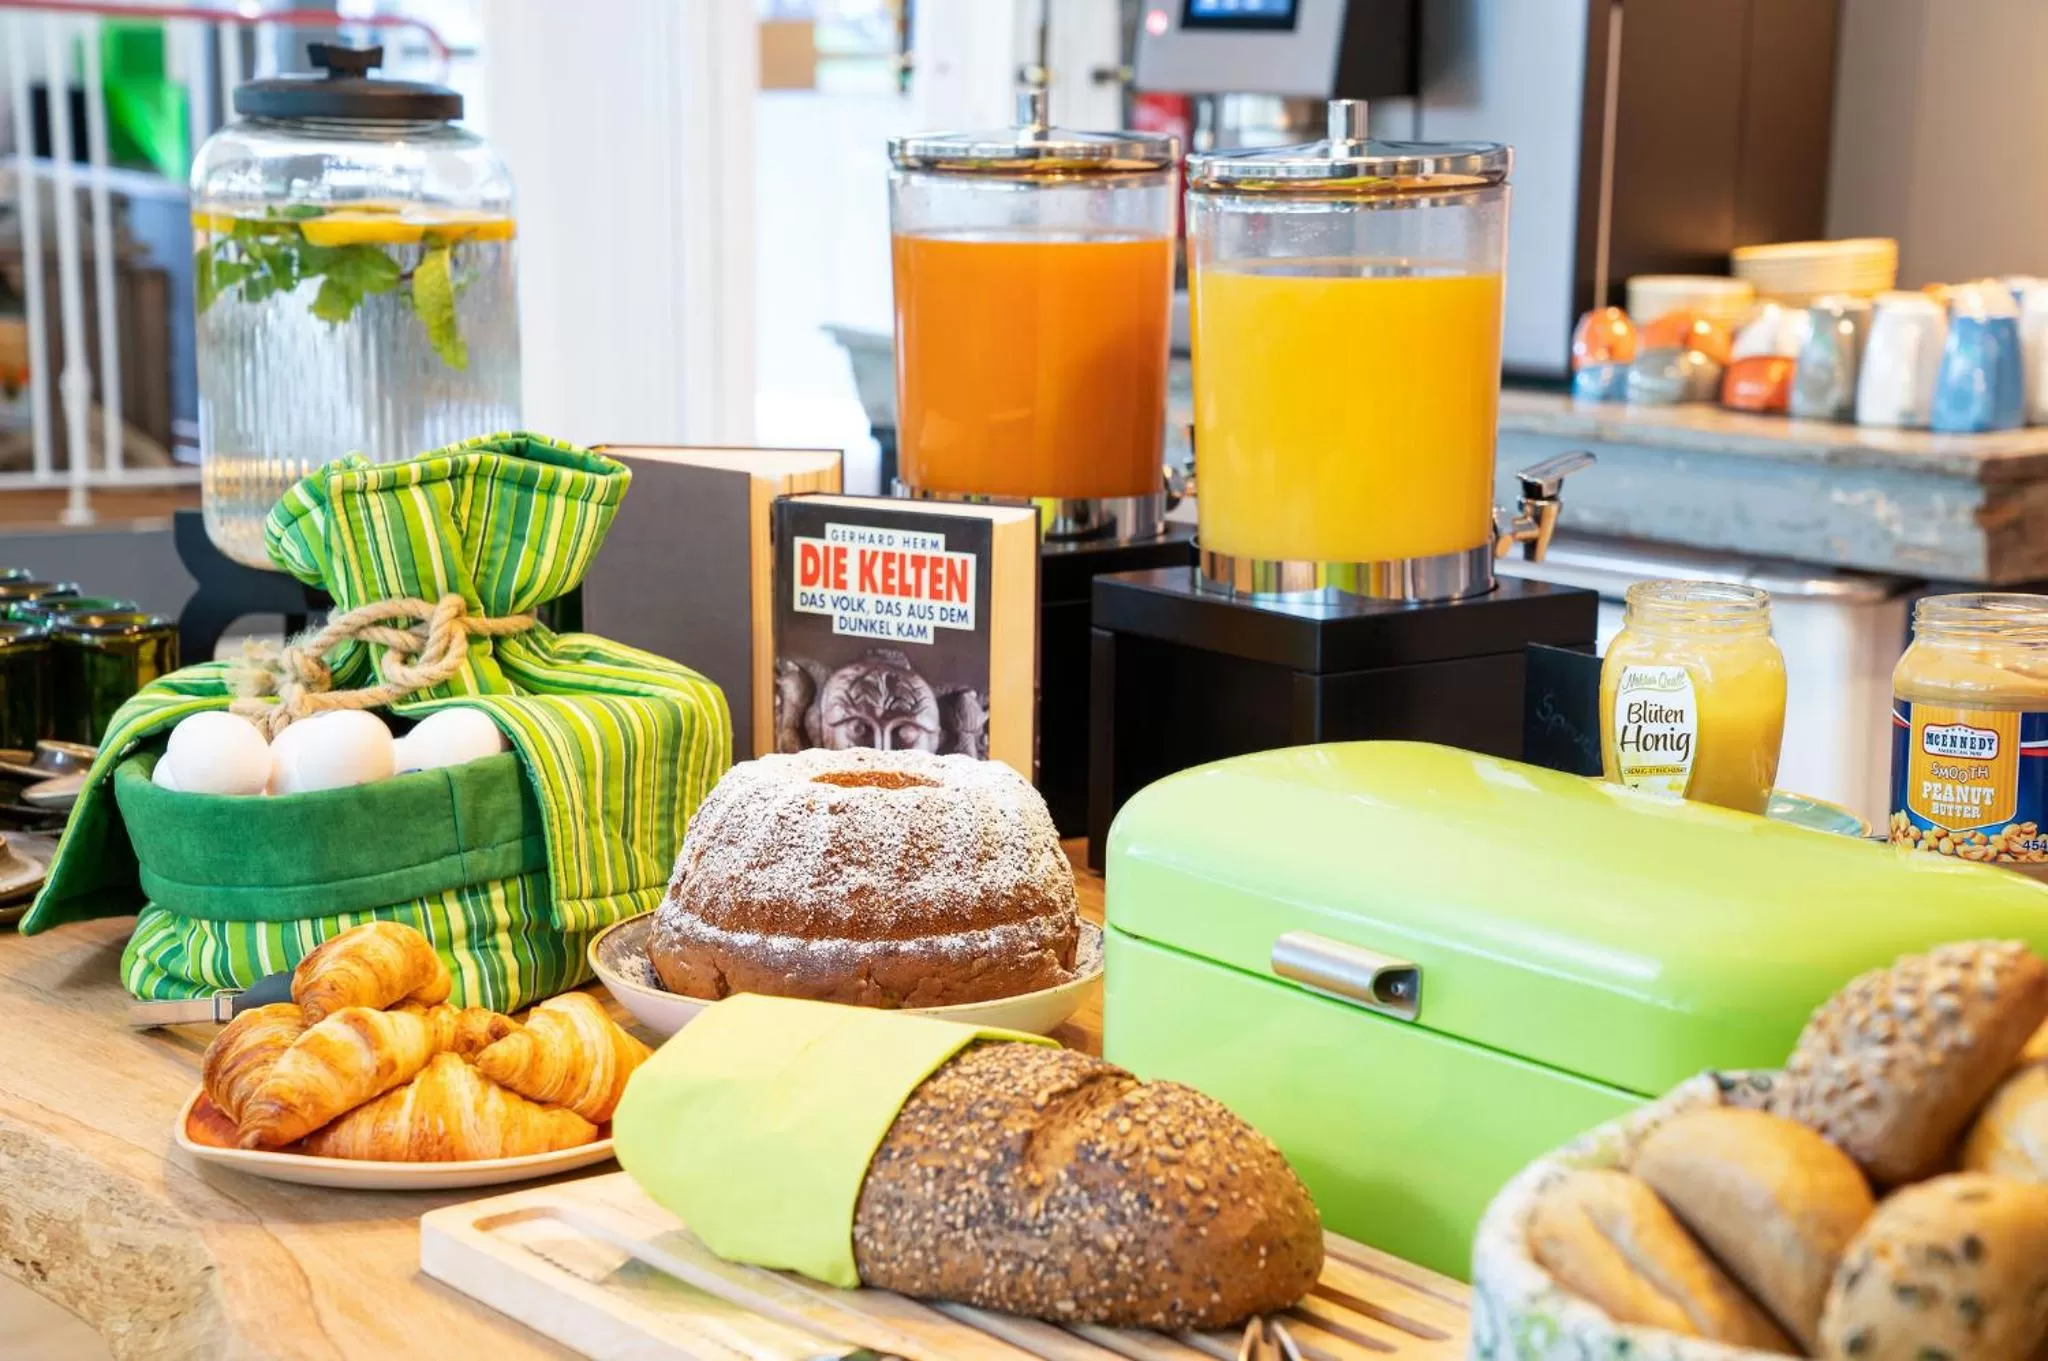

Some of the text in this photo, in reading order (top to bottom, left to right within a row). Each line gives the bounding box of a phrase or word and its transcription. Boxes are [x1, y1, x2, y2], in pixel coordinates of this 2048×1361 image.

[831, 528, 940, 549] GERHARD HERM
[800, 542, 968, 604] DIE KELTEN
[799, 591, 969, 625] DAS VOLK, DAS AUS DEM
[838, 615, 928, 640] DUNKEL KAM
[1627, 700, 1684, 724] Blüten
[1620, 725, 1691, 762] Honig
[1931, 761, 1990, 784] SMOOTH
[1922, 780, 1995, 806] PEANUT
[1931, 802, 1982, 819] BUTTER
[2022, 839, 2048, 851] 454
